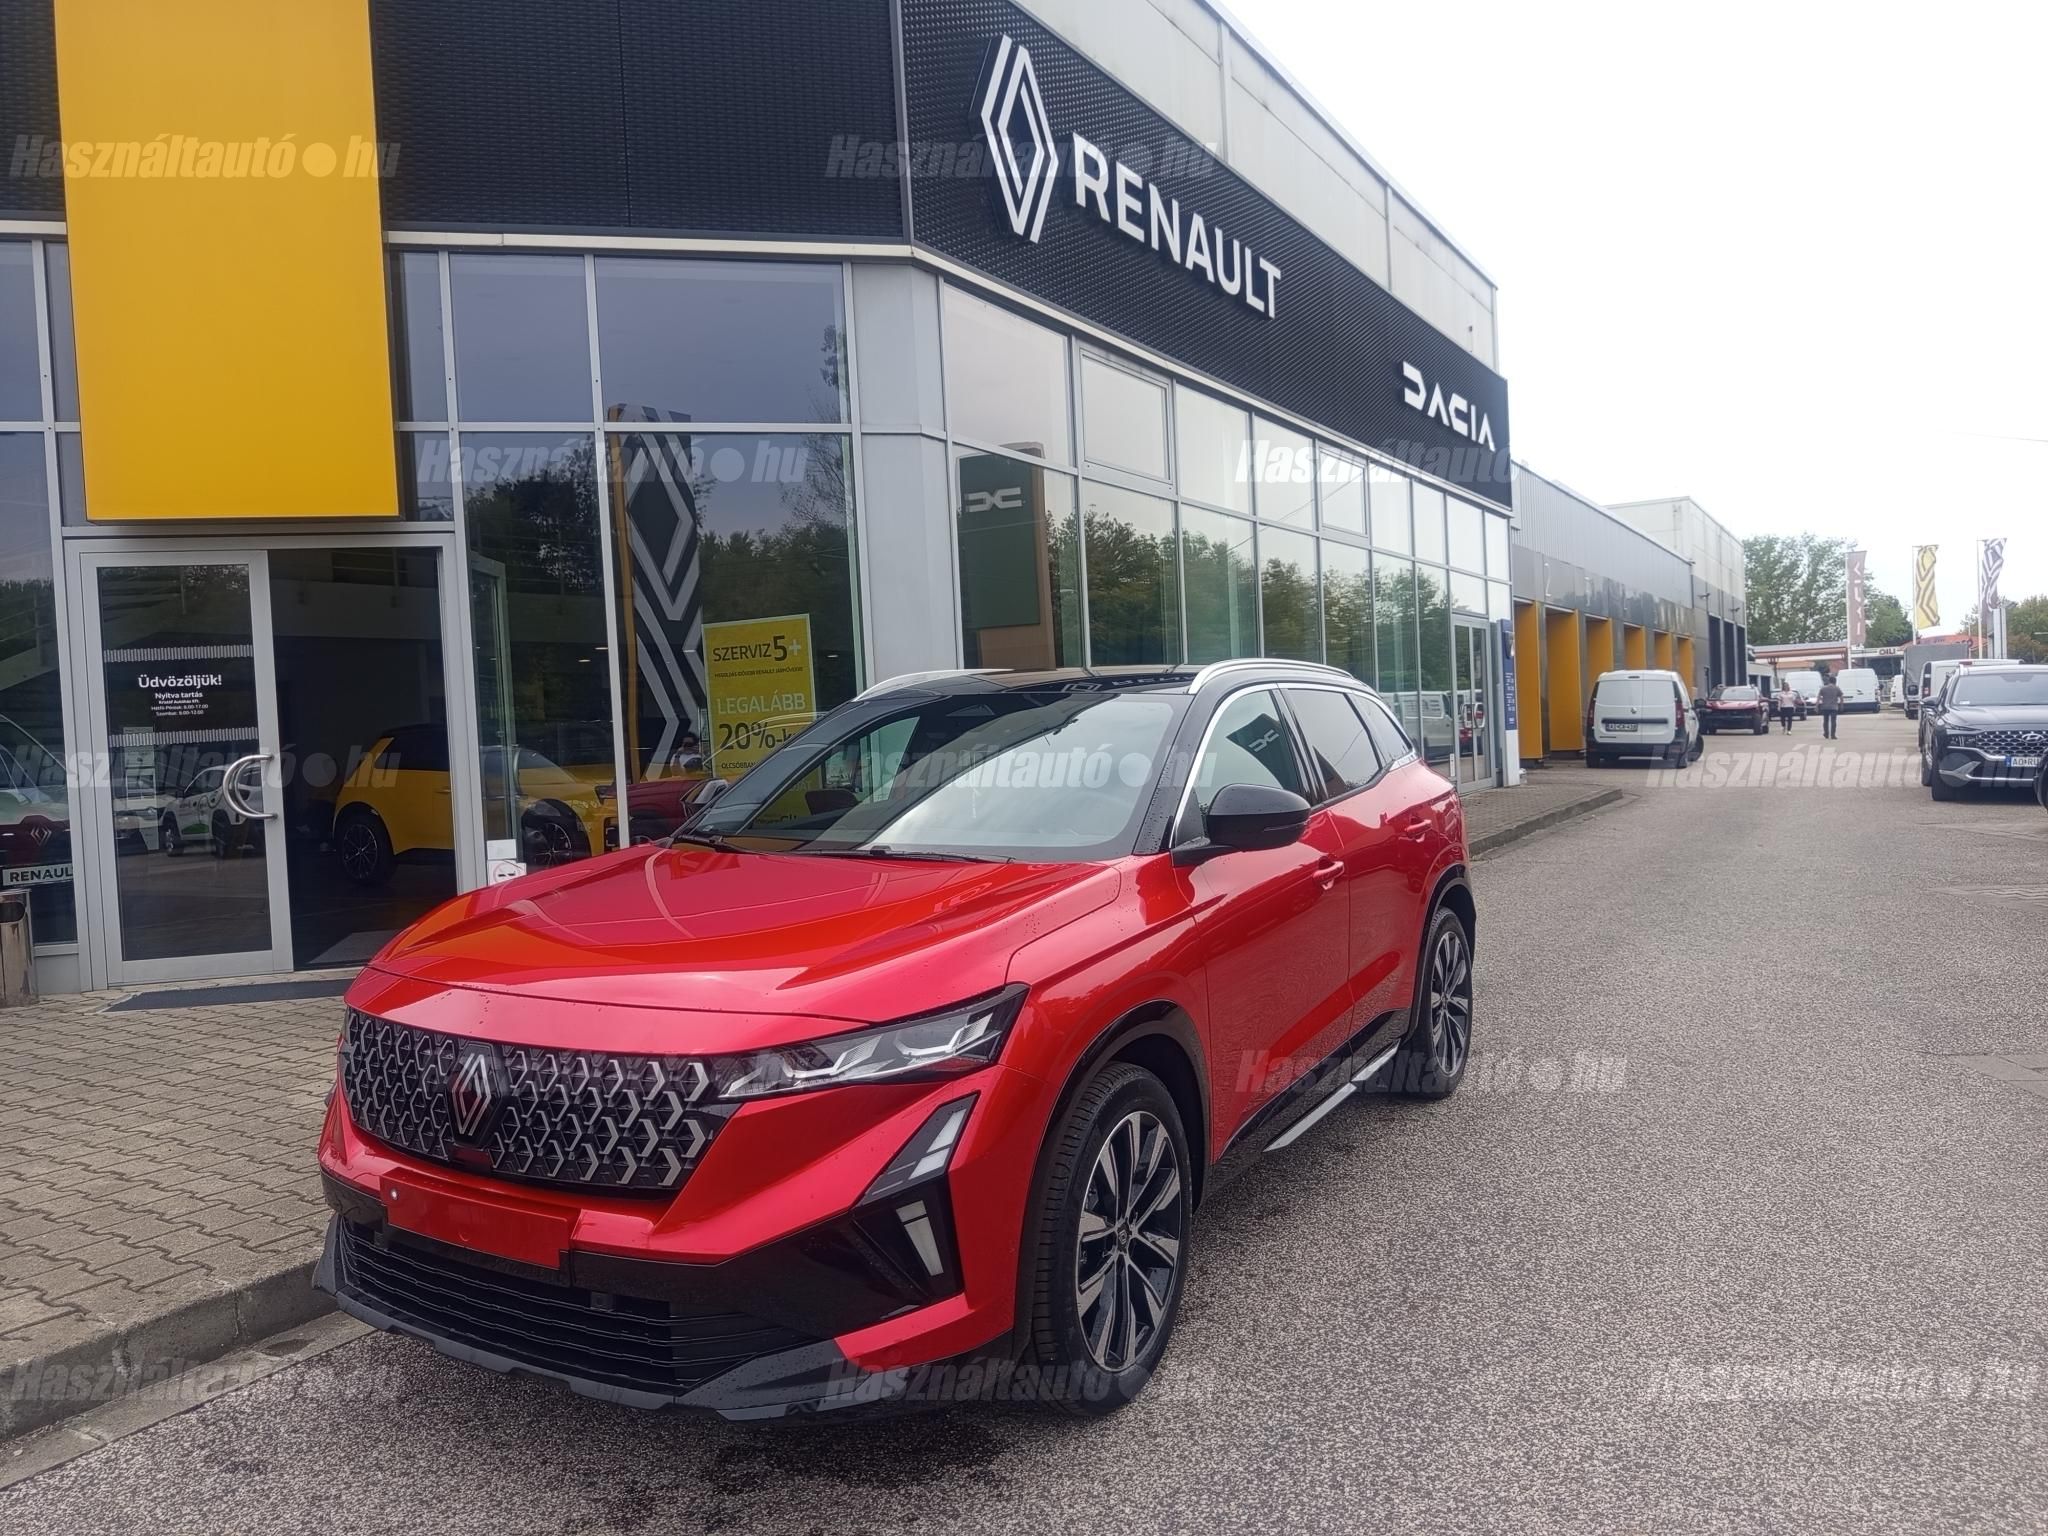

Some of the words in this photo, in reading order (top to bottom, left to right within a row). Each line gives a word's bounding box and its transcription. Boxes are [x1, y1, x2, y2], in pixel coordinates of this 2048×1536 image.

[1073, 132, 1281, 319] RENAULT
[1403, 361, 1495, 452] DACIA
[713, 643, 772, 662] SZERVIZ
[138, 674, 222, 689] Üdvözöljük!
[154, 692, 180, 700] Nyitva
[718, 690, 806, 714] LEGALÁBB
[719, 721, 795, 750] 20%-k
[10, 867, 73, 882] RENAUL
